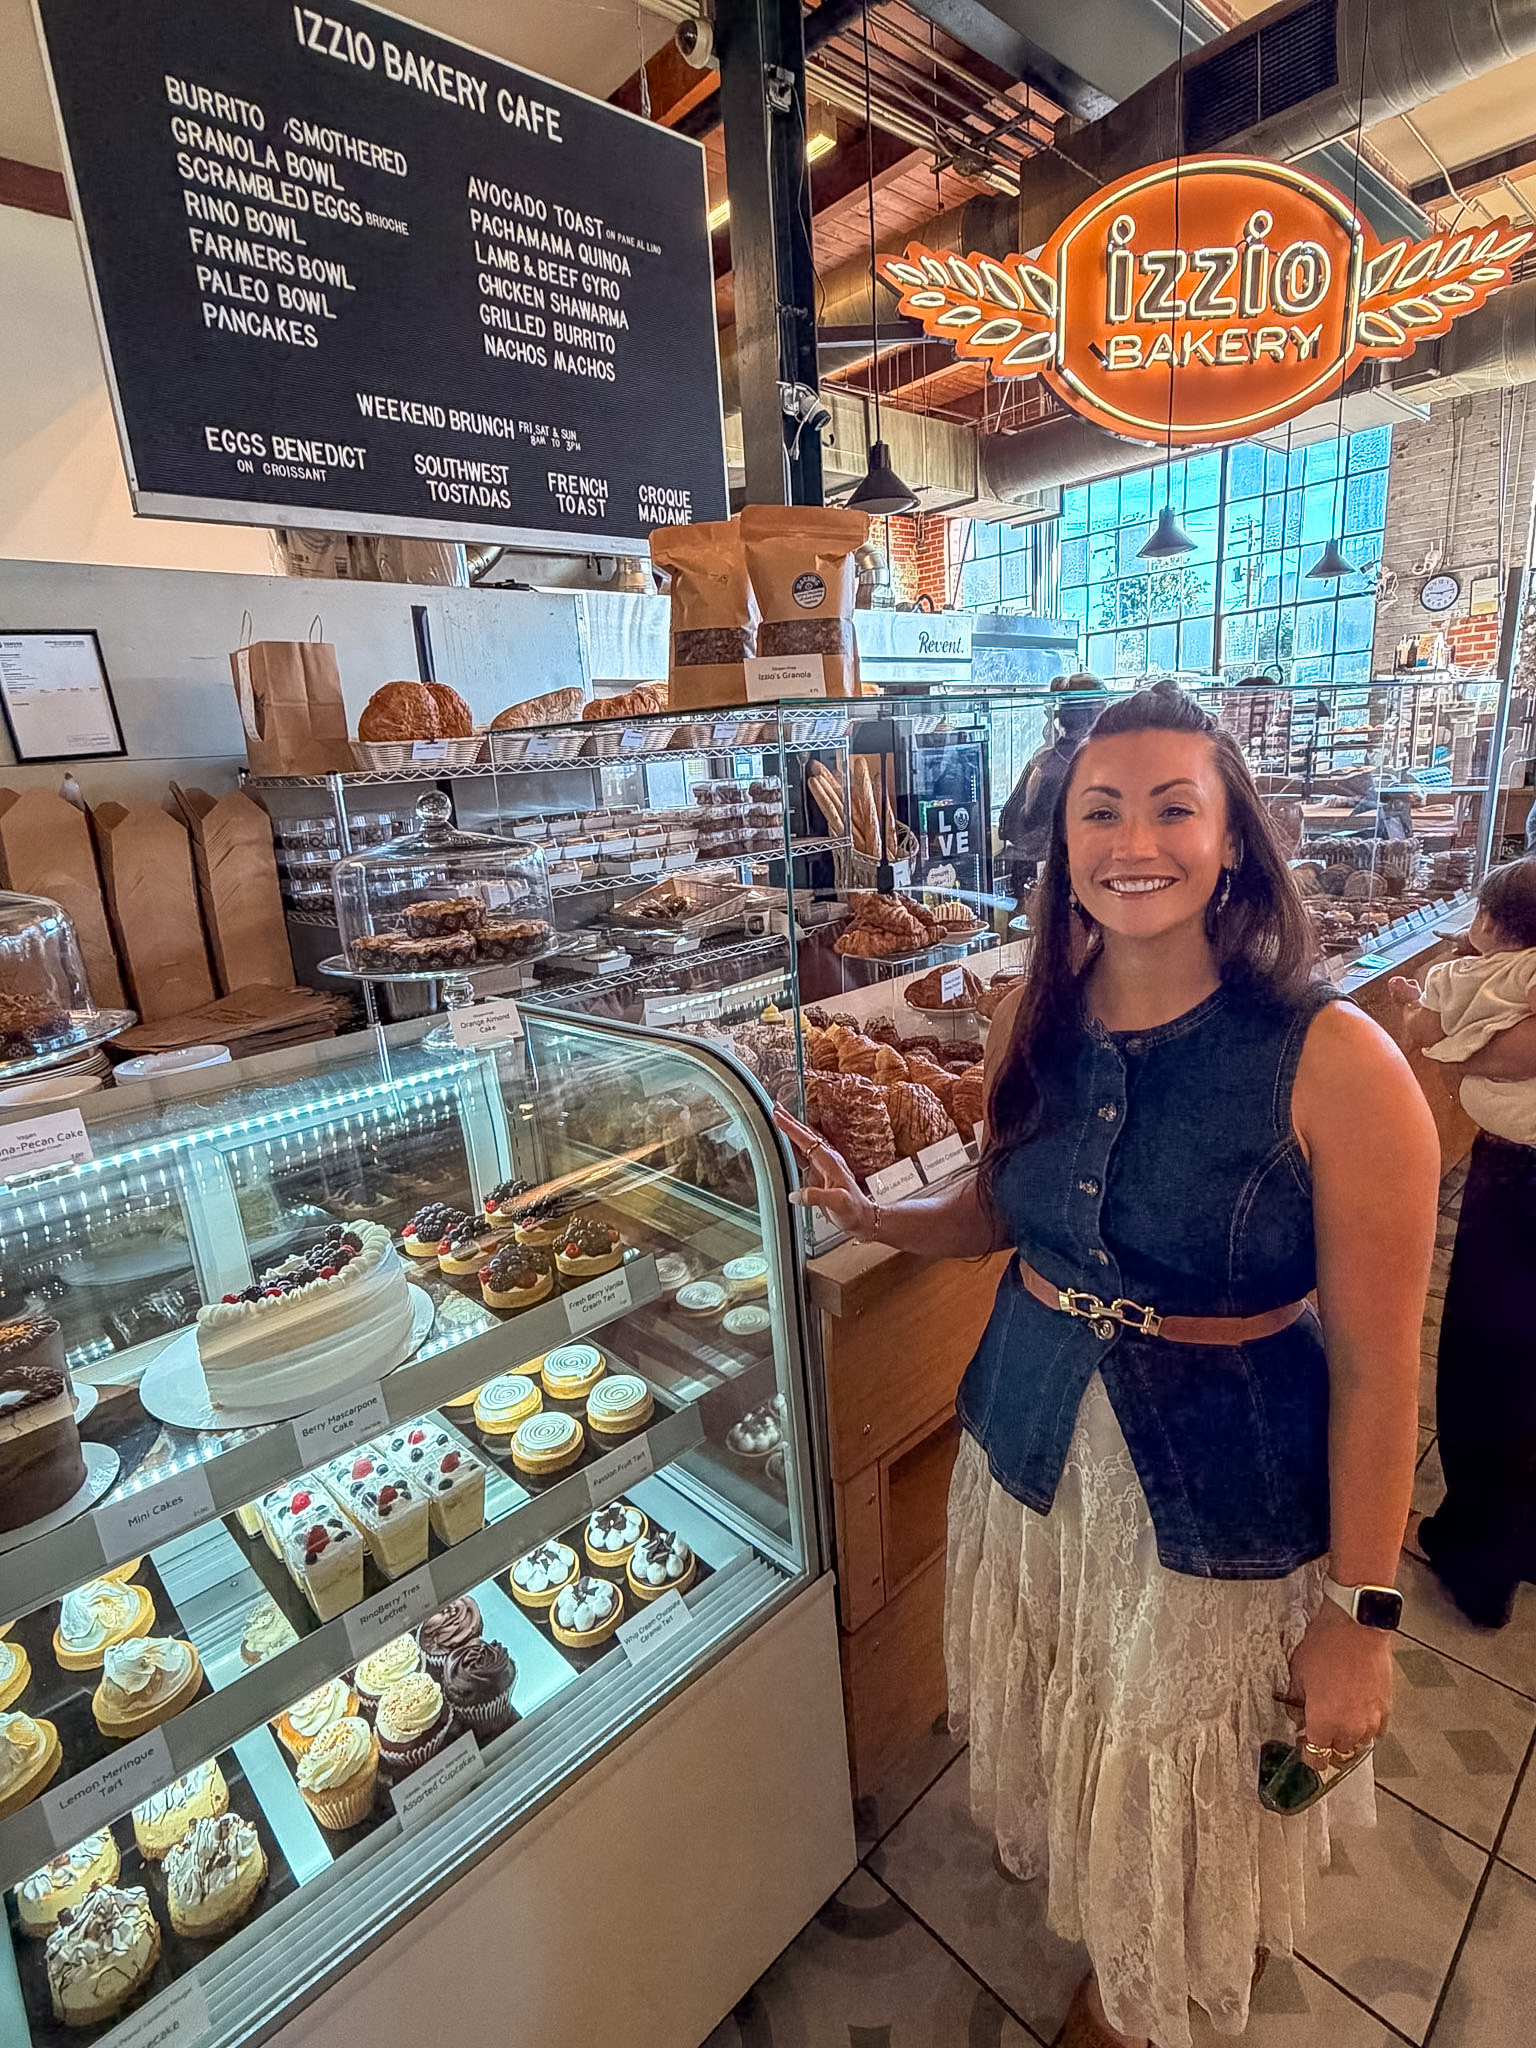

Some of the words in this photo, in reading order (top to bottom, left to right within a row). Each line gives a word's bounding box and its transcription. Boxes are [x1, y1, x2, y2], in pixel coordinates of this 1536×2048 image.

[293, 5, 376, 71] IZZIO
[382, 39, 488, 114] BAKERY
[497, 88, 563, 143] CAFE
[164, 75, 266, 132] BURRITO
[171, 116, 281, 174] GRANOLA
[285, 151, 345, 192] BOWL
[176, 152, 309, 212] SCRAMBLED
[312, 192, 364, 227] EGGS
[365, 211, 410, 237] BRIOCHE
[467, 175, 548, 222] AVOCADO
[553, 204, 604, 240] TOAST
[605, 229, 616, 240] ON
[617, 232, 636, 247] PANE
[636, 239, 645, 250] AL
[183, 189, 239, 228] RINO
[245, 208, 307, 246] BOWL
[188, 227, 295, 276] FARMERS
[297, 254, 357, 292] BOWL
[470, 208, 575, 260] PACHAMAMA
[578, 242, 631, 277] QUINOA
[474, 240, 520, 274] LAMB
[523, 254, 536, 278] &
[537, 260, 578, 290] BEEF
[581, 272, 621, 301] GYRO
[196, 265, 269, 304] PALEO
[277, 282, 337, 319] BOWL
[478, 272, 545, 310] CHICKEN
[550, 292, 629, 330] SHAWARMA
[202, 302, 319, 349] PANCAKES
[479, 303, 546, 338] GRILLED
[553, 321, 615, 355] BURRITO
[484, 333, 548, 368] NACHOS
[554, 350, 616, 383] MACHOS
[1107, 324, 1323, 370] BAKERY
[356, 393, 446, 429] WEEKEND
[448, 409, 515, 440] BRUNCH
[552, 427, 560, 438] &
[561, 428, 577, 441] SUN
[204, 426, 267, 457] EGGS
[271, 435, 367, 470] BENEDICT
[530, 435, 546, 447] 8AM
[551, 438, 560, 448] TO
[565, 440, 581, 452] 3PM
[236, 459, 254, 474] ON
[262, 462, 327, 483] CROISSANT
[414, 453, 509, 486] SOUTHWEST
[547, 471, 609, 499] FRENCH
[426, 480, 511, 510] TOSTADAS
[555, 493, 606, 518] TOAST
[638, 485, 692, 510] CROQUE
[758, 672, 780, 681] Izzio's
[782, 671, 811, 680] Granola
[460, 1020, 485, 1029] Orange
[486, 1013, 511, 1024] Almond
[480, 1025, 496, 1034] Cake
[0, 1136, 55, 1156] na-Pecan
[56, 1130, 84, 1142] Cake
[569, 1297, 587, 1310] Fresh
[587, 1289, 604, 1302] Berry
[604, 1279, 624, 1293] Vanilla
[582, 1300, 602, 1313] Cream
[603, 1292, 616, 1303] Tart
[302, 1421, 326, 1438] Berry
[327, 1397, 378, 1425] Mascarpone
[332, 1420, 354, 1434] Cake
[127, 1509, 150, 1528] Mini
[152, 1495, 184, 1515] Cakes
[401, 1583, 421, 1599] Tres
[378, 1603, 407, 1625] Leches
[623, 1631, 639, 1645] Whip
[638, 1618, 657, 1635] Cream
[661, 1615, 674, 1626] Tart
[59, 1780, 101, 1810] Lemon
[102, 1748, 155, 1783] Meringue
[98, 1778, 124, 1798] Tart
[402, 1780, 438, 1814] Assorted
[438, 1754, 477, 1785] Cupcakes
